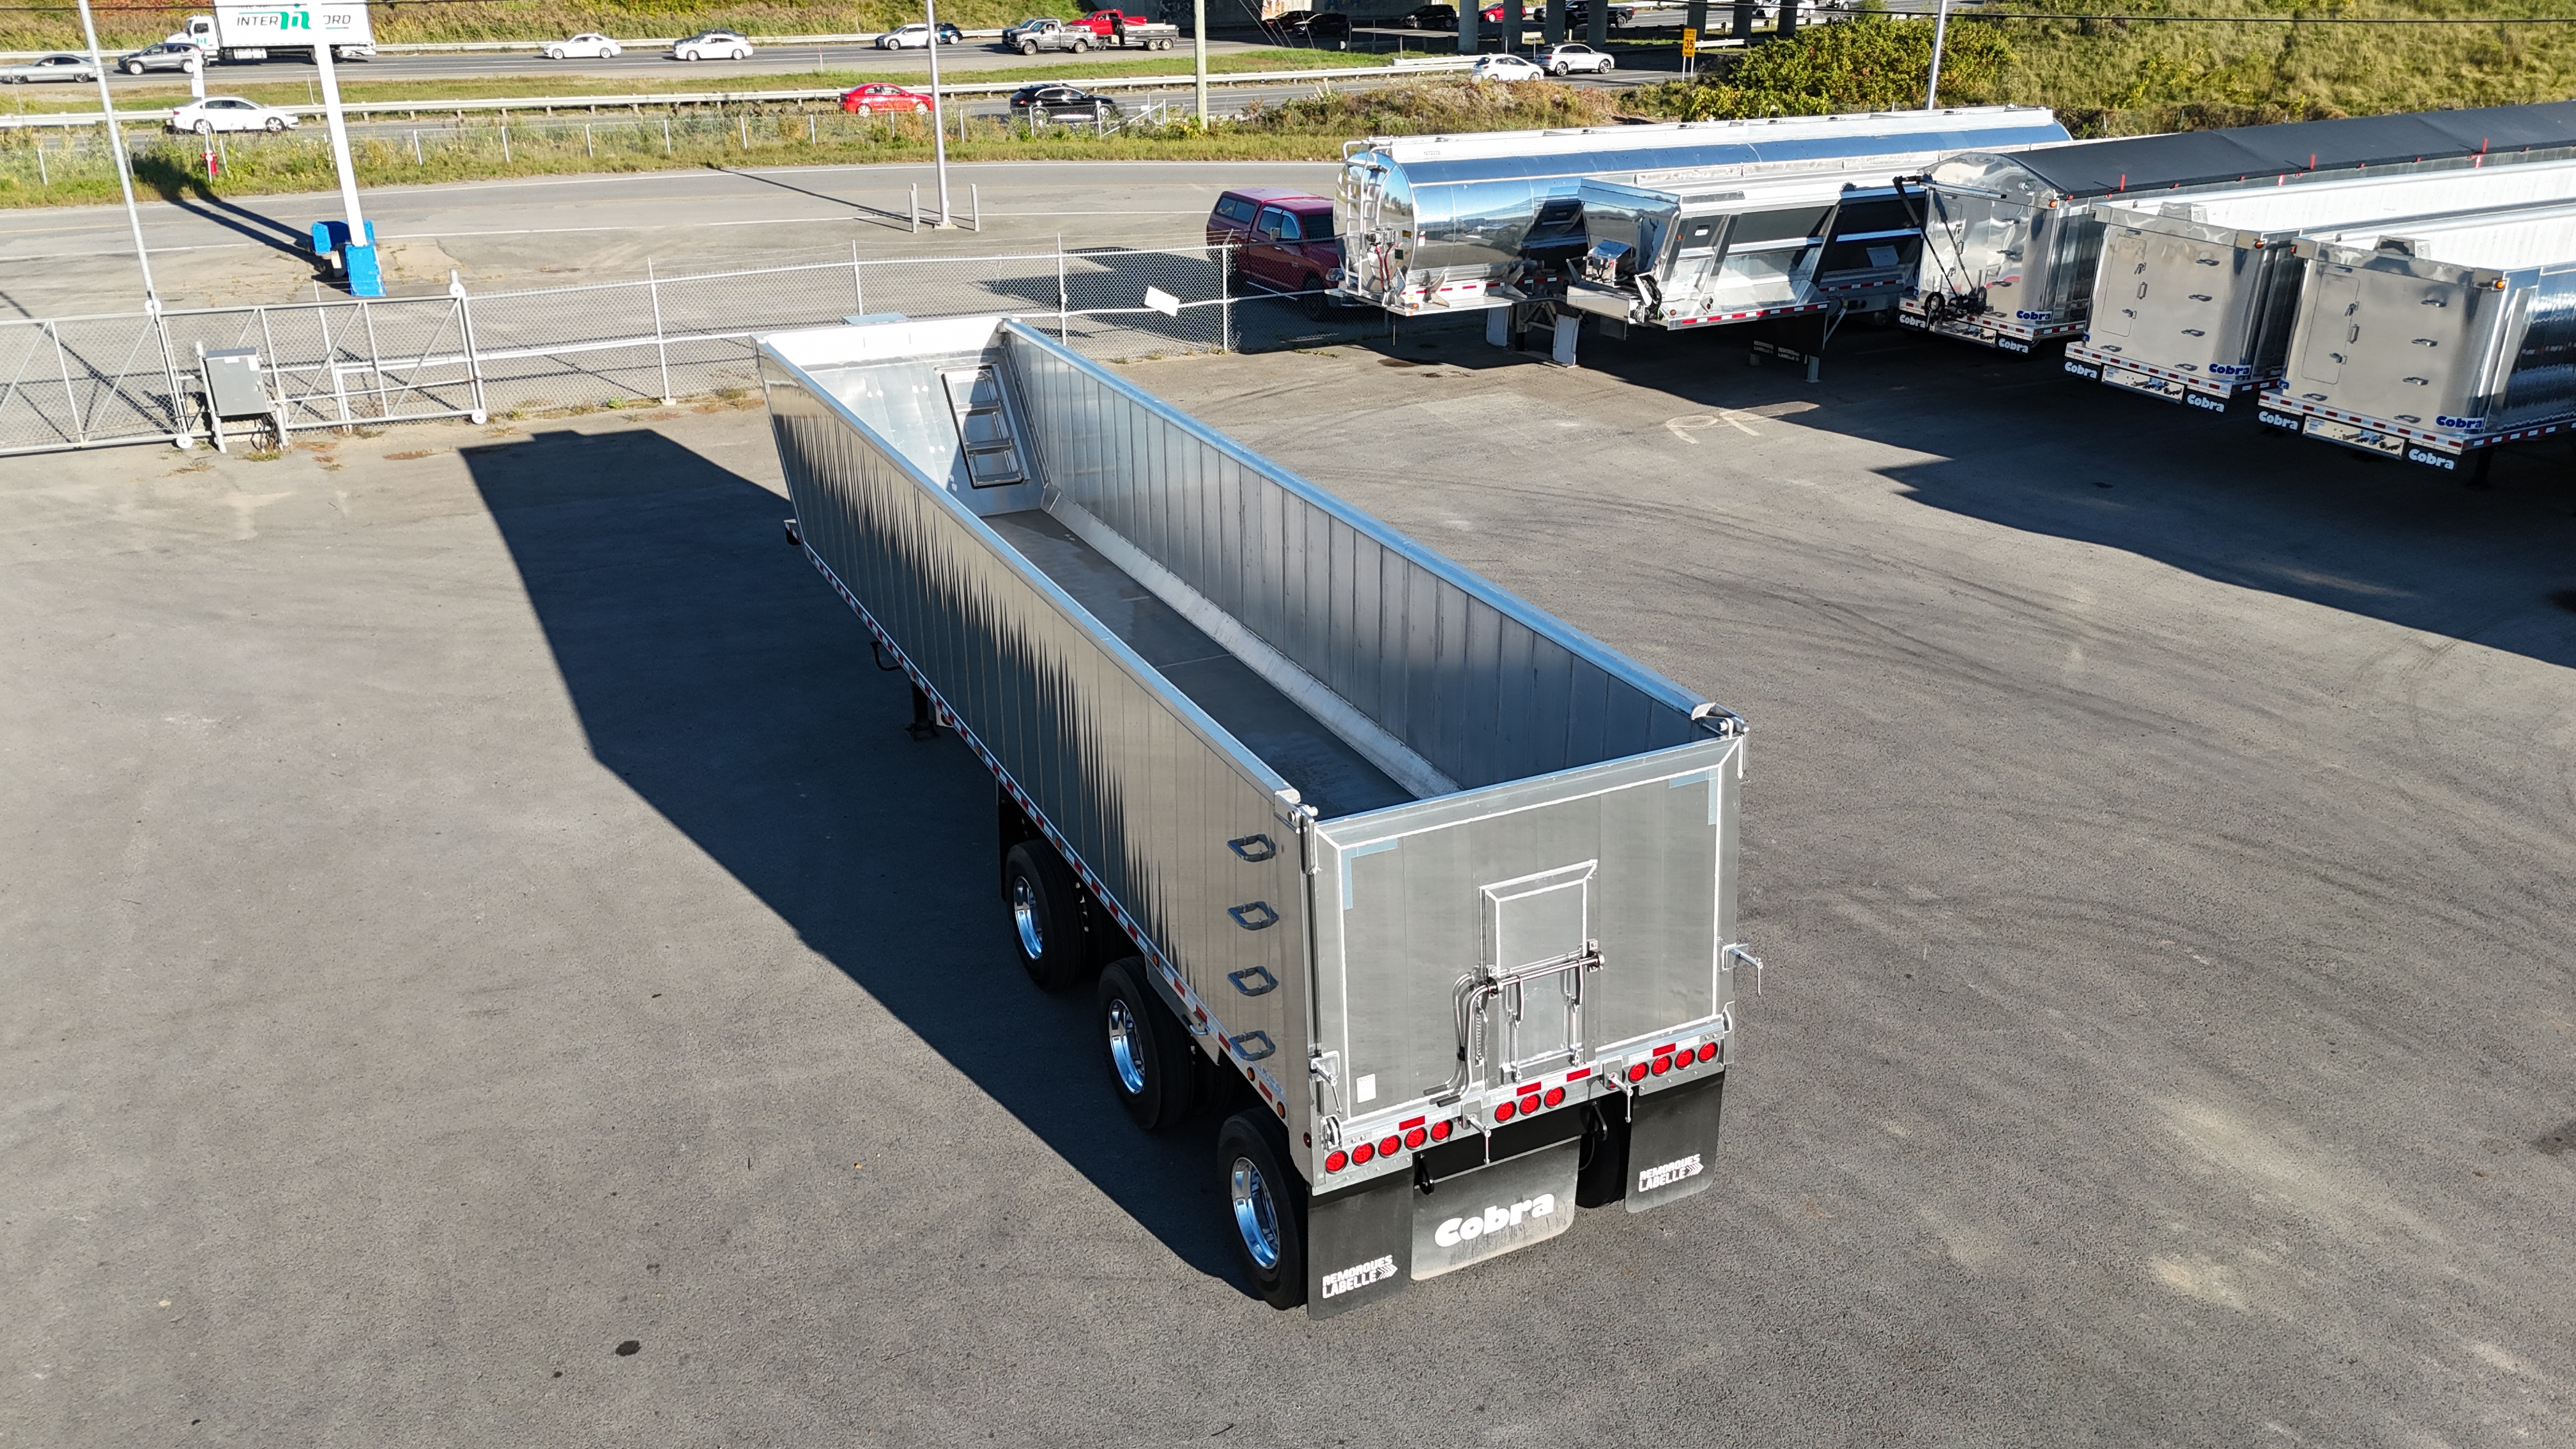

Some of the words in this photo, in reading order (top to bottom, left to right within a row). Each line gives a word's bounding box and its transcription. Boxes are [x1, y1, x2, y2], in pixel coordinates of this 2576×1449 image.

[237, 16, 279, 26] INTER
[1685, 39, 1694, 50] 35
[1899, 314, 1926, 328] Cobra
[2016, 310, 2051, 320] Cobra
[1998, 337, 2028, 353] Cobra
[2064, 361, 2097, 379] Cobra
[2209, 363, 2250, 375] Cobra
[2186, 394, 2225, 413] Cobra
[2258, 411, 2299, 431] Cobra
[2435, 415, 2483, 429] Cobra
[2408, 448, 2455, 470] Cobra
[1639, 1153, 1701, 1181] REMORQUES
[1638, 1167, 1687, 1193] LABELLE
[1434, 1193, 1554, 1247] Cobra
[1322, 1254, 1393, 1287] REMORQUES
[1322, 1270, 1377, 1299] LABELLE
